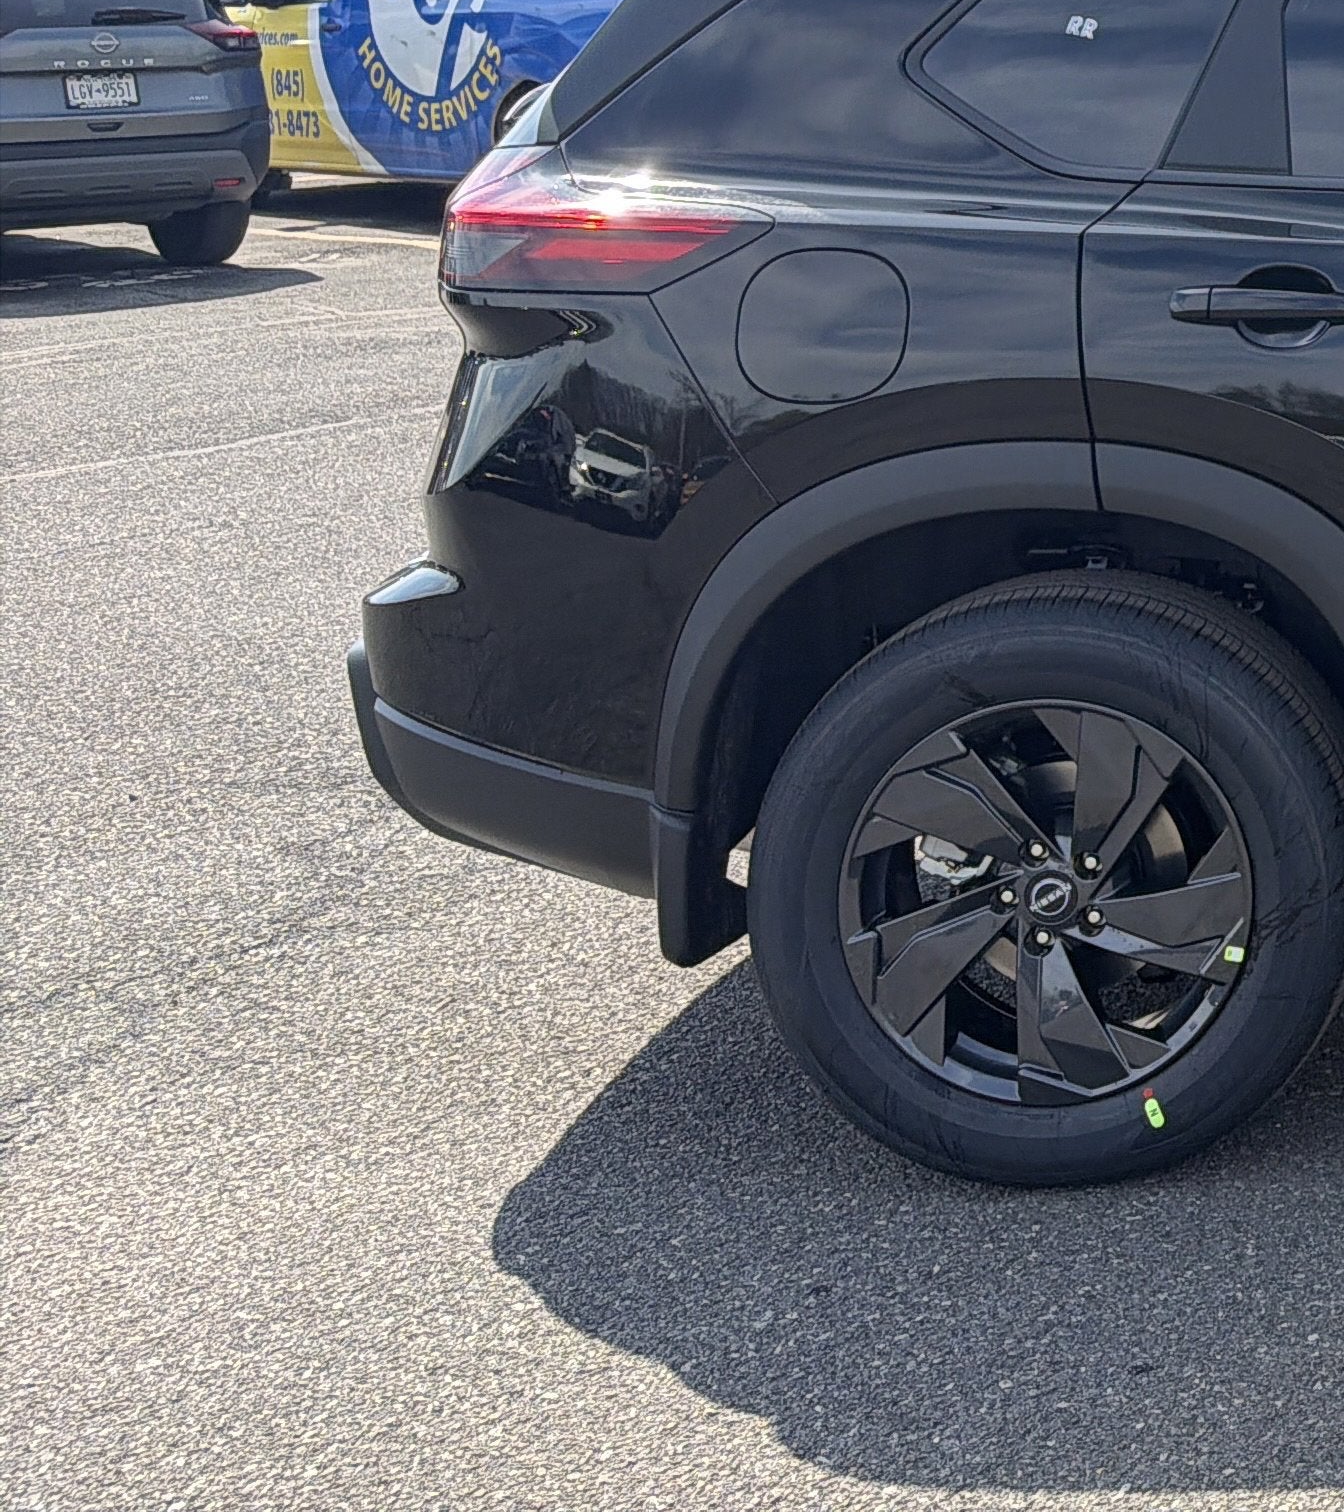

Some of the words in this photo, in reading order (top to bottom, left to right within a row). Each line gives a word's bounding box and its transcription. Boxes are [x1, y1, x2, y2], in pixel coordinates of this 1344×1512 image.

[1065, 15, 1098, 39] RR
[53, 58, 154, 69] ROGUE
[101, 81, 132, 99] 9551
[271, 67, 305, 102] (845)
[358, 36, 414, 124] HOME
[417, 38, 502, 131] SERVICES
